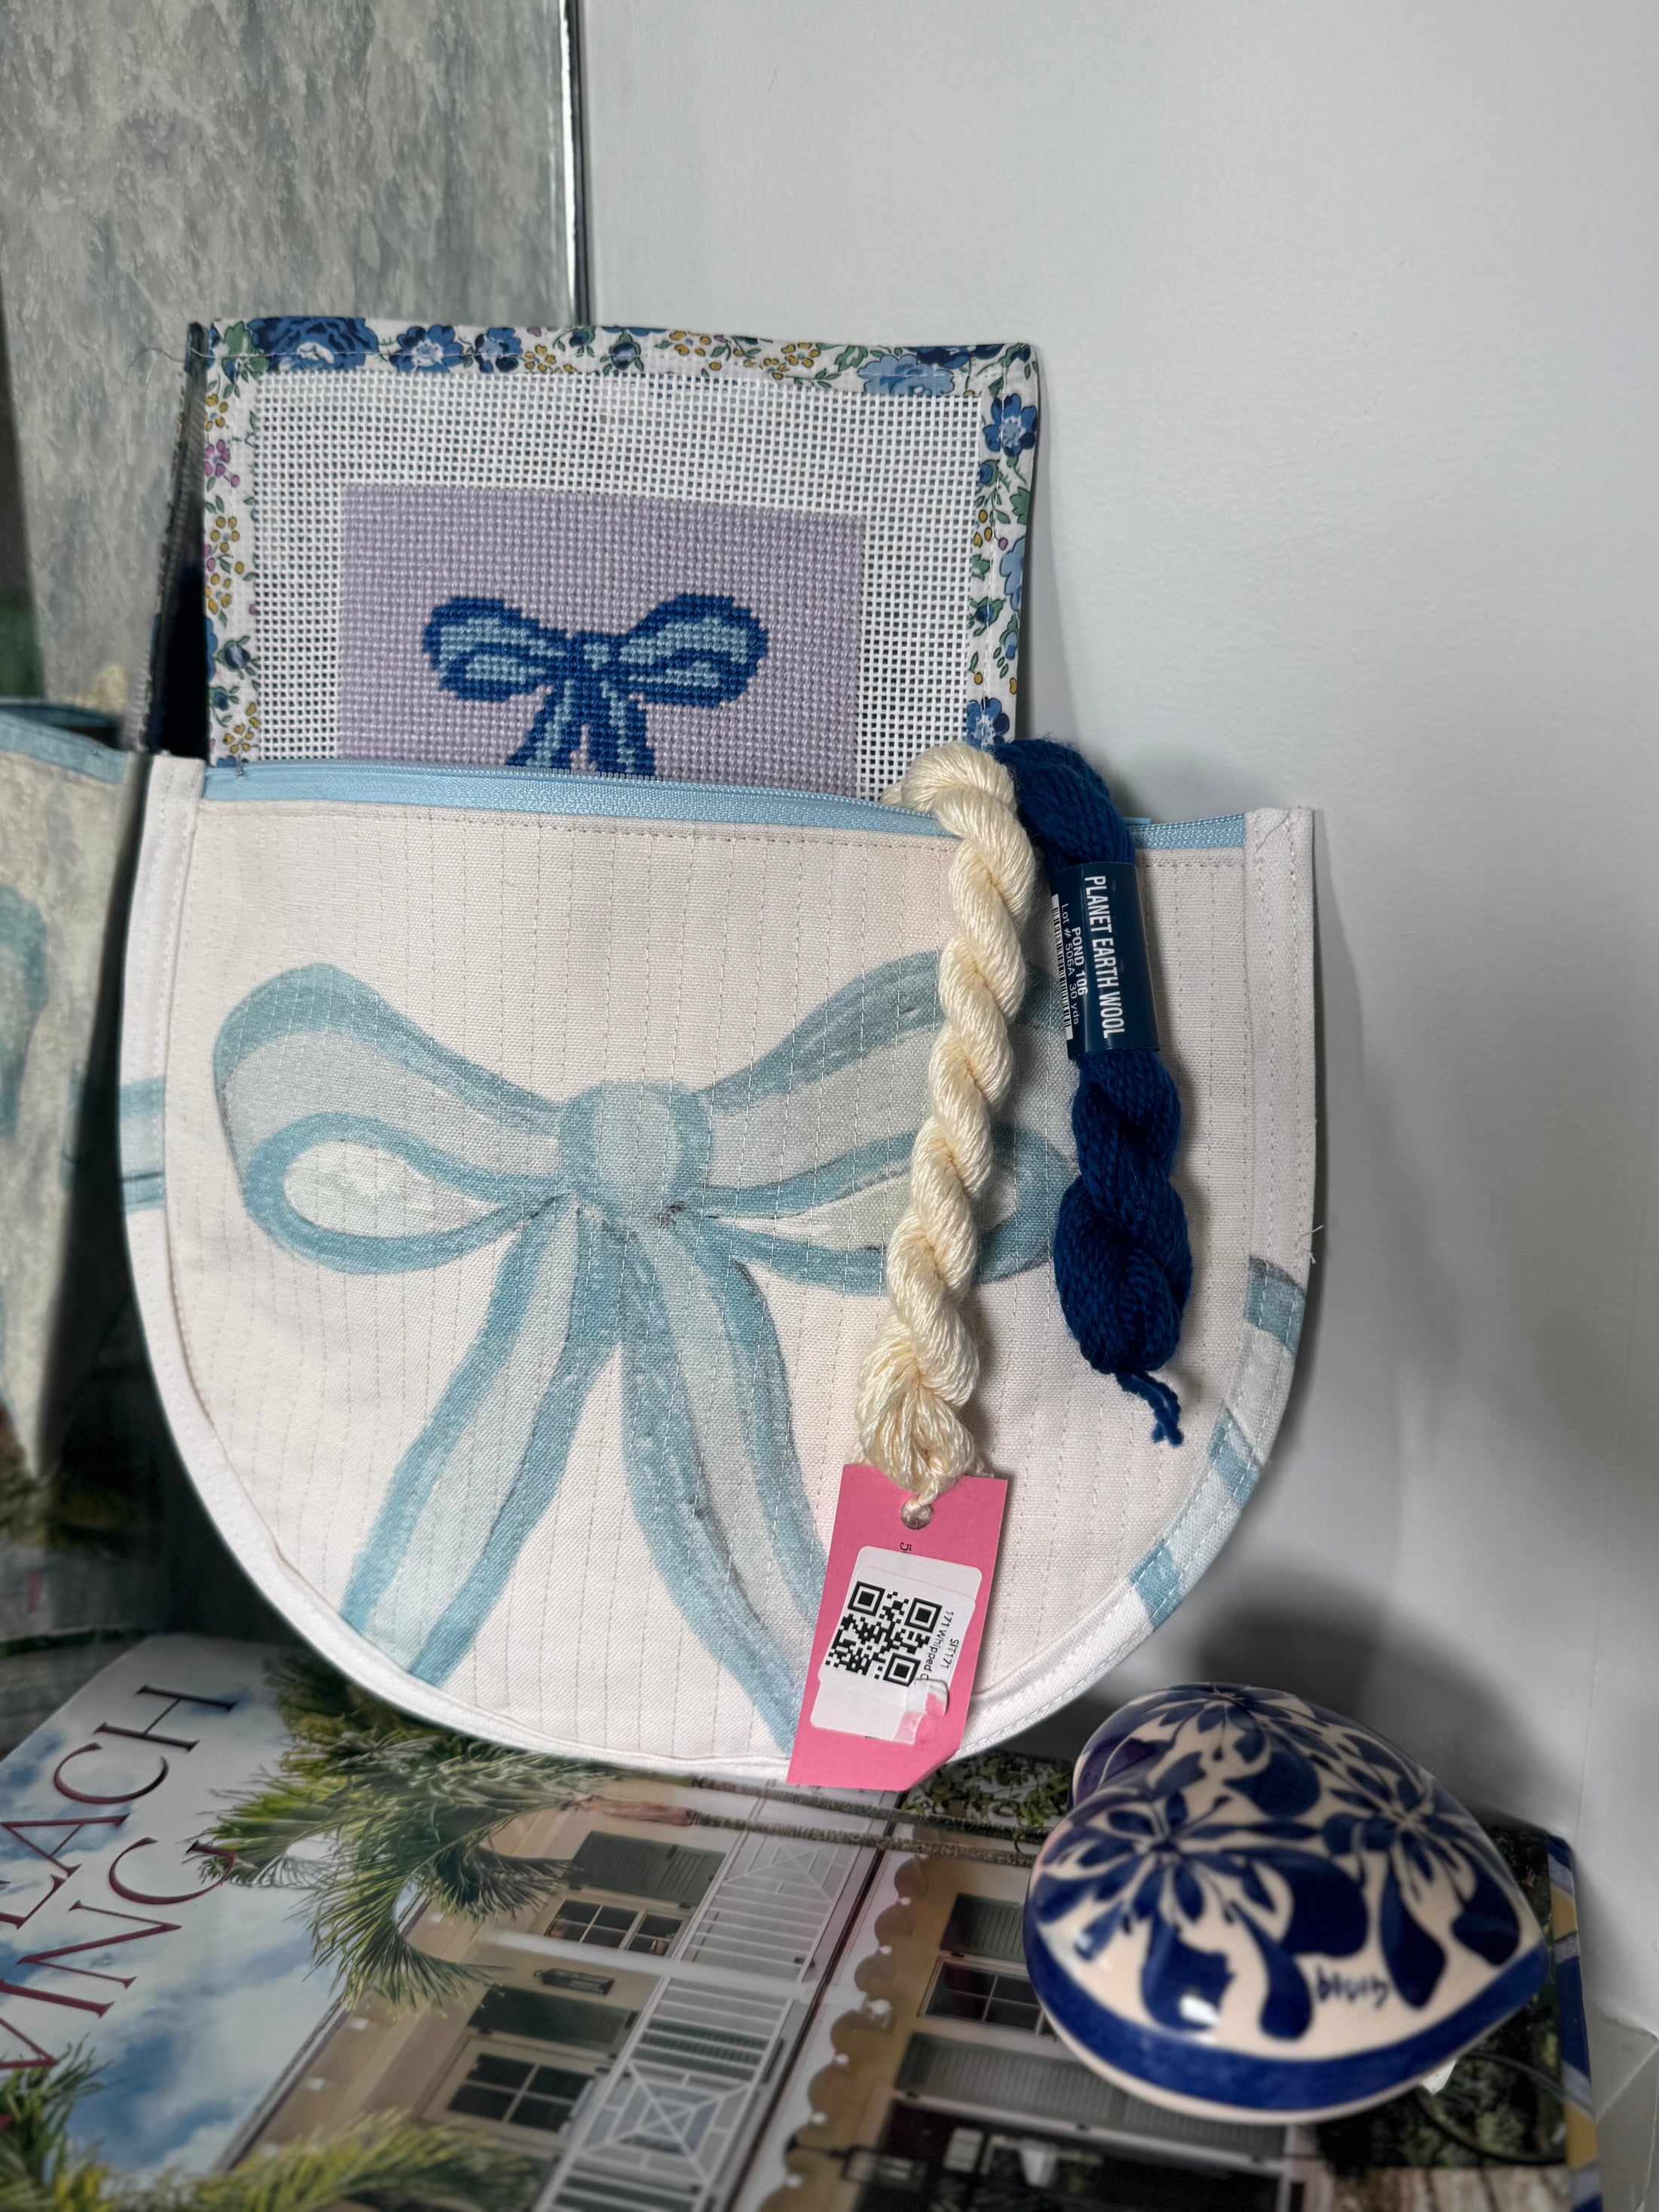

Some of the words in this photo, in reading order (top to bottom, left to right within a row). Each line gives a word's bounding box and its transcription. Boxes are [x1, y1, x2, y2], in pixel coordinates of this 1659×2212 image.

[1061, 904, 1070, 924] Lot
[1084, 876, 1112, 933] PLANET
[1064, 928, 1071, 938] #
[1072, 926, 1084, 966] POND
[1065, 943, 1075, 976] 506A
[1092, 937, 1119, 988] EARTH
[1069, 983, 1078, 999] 30
[1076, 971, 1087, 996] 106
[1099, 991, 1125, 1039] WOOL
[900, 1542, 912, 1553] 5
[941, 1611, 954, 1628] 171
[924, 1629, 947, 1672] Whipped
[940, 1638, 959, 1669] SIT171
